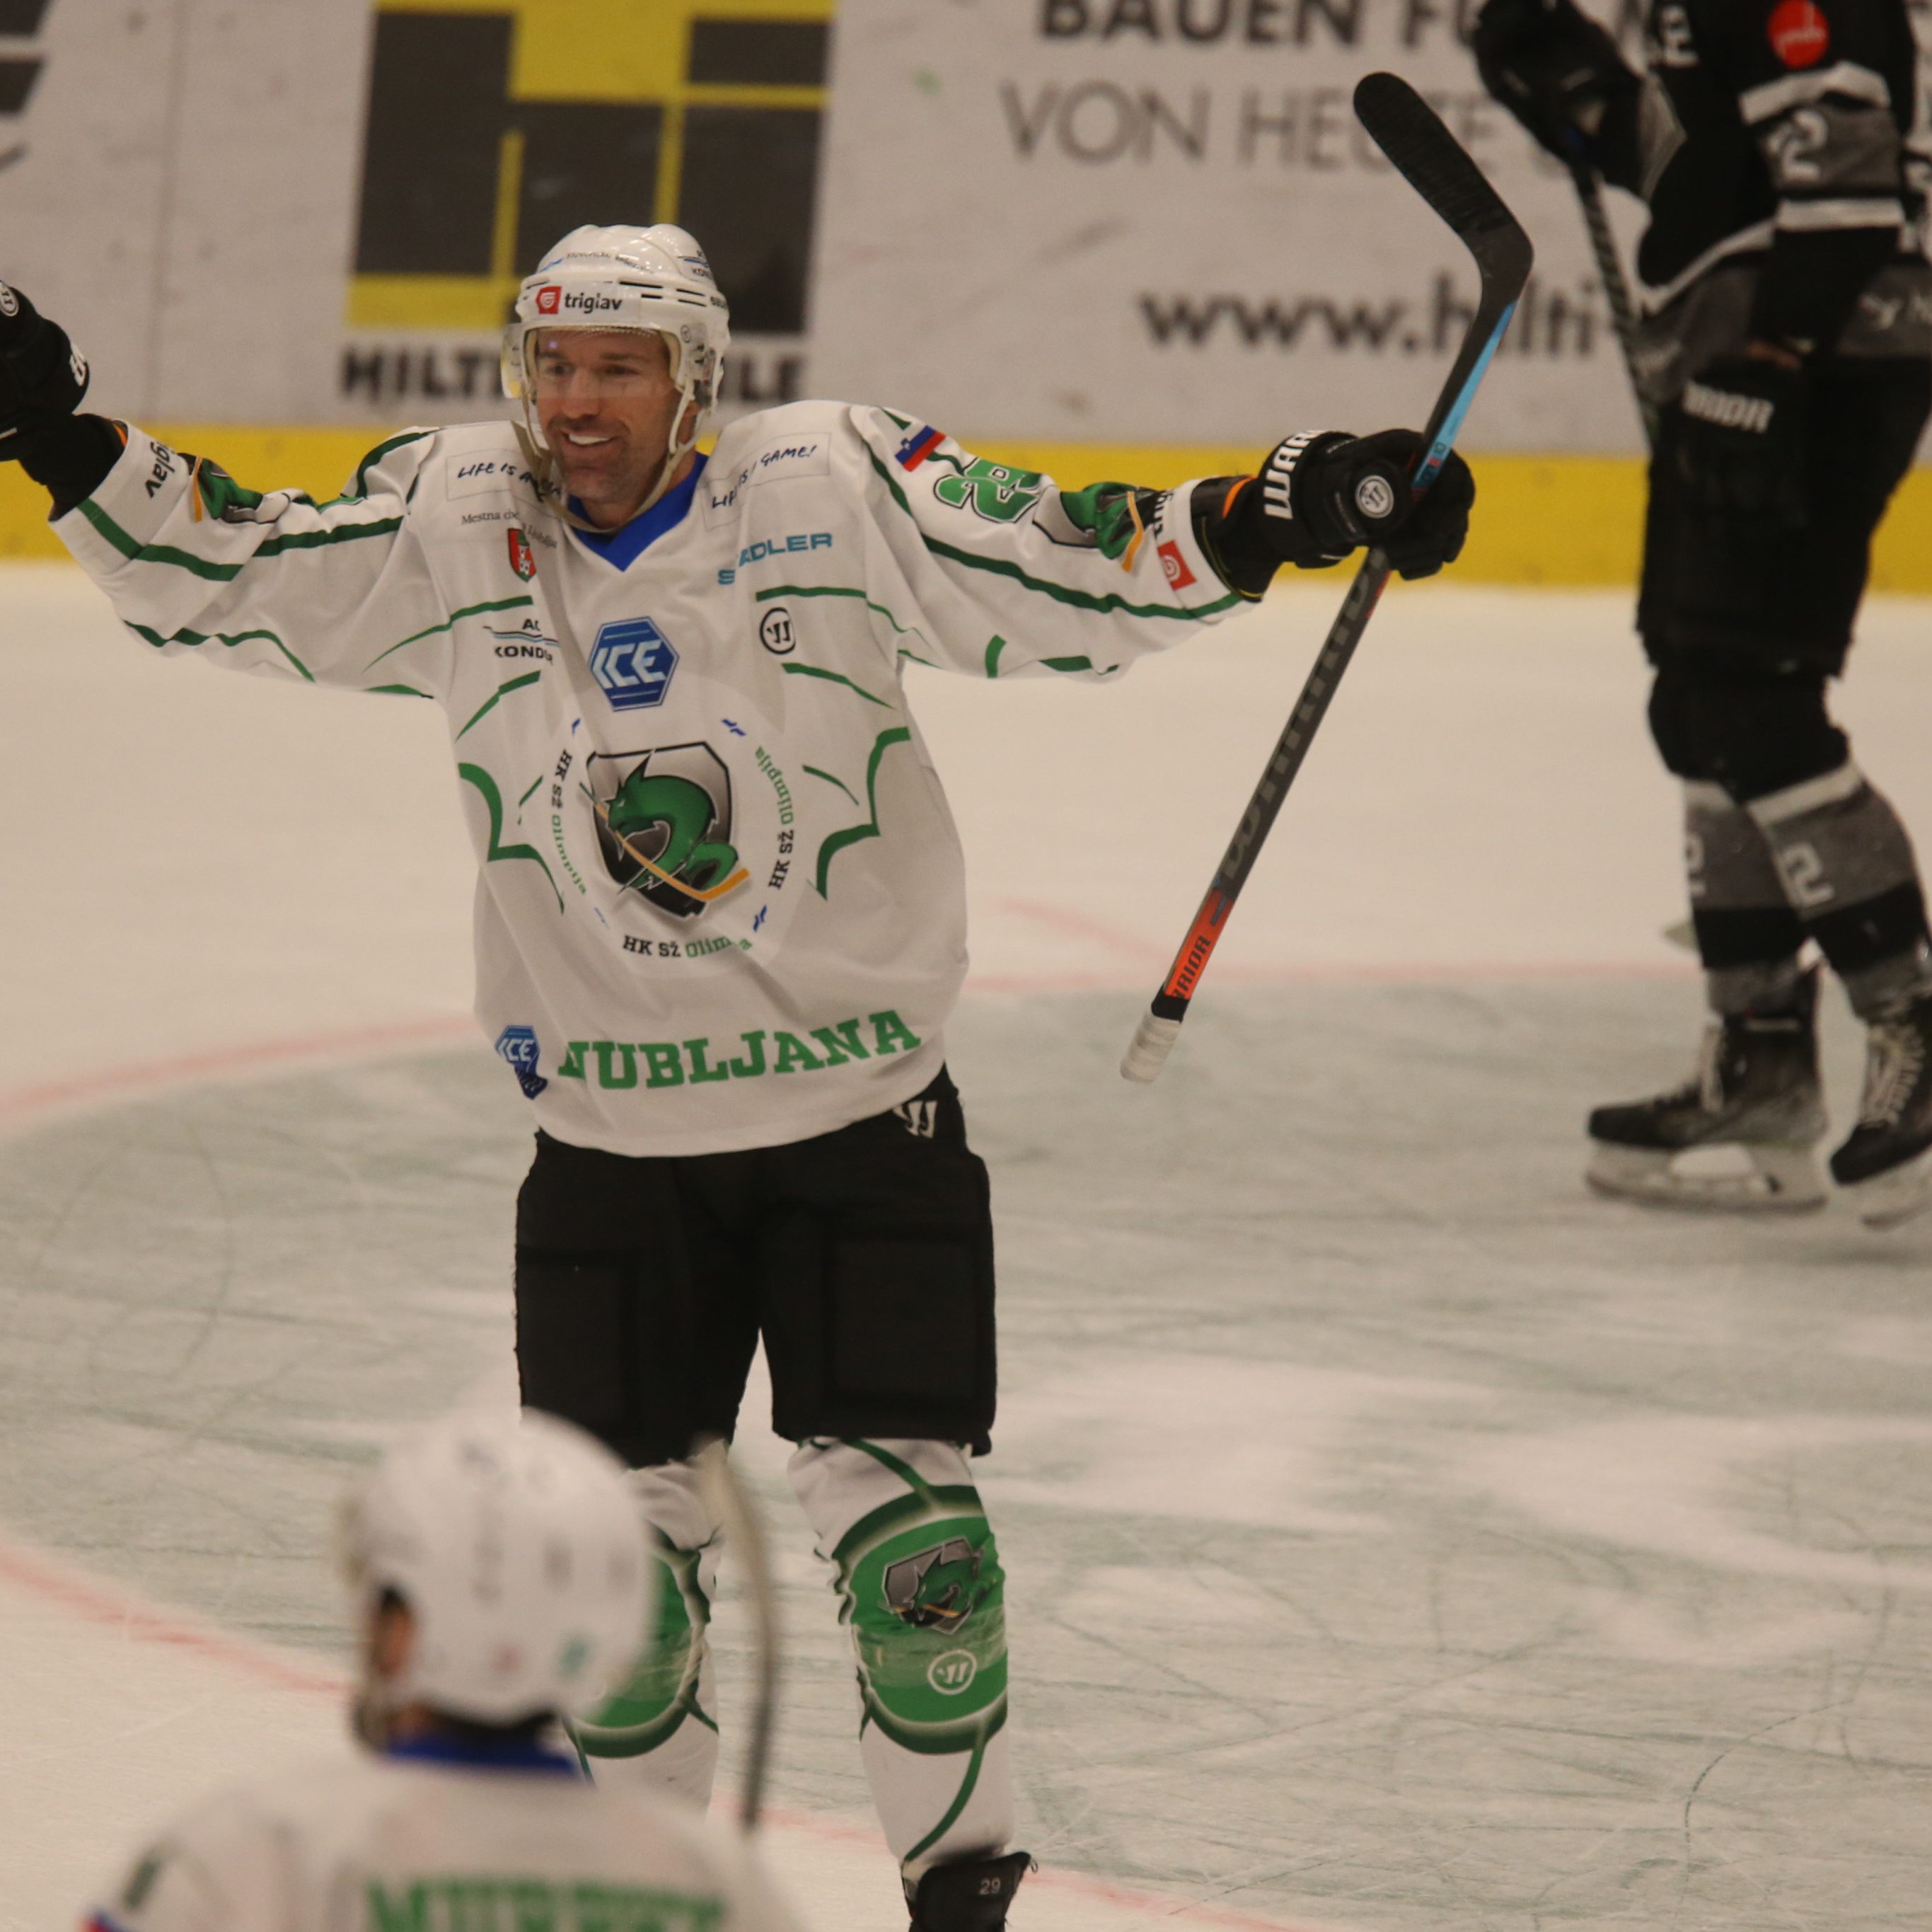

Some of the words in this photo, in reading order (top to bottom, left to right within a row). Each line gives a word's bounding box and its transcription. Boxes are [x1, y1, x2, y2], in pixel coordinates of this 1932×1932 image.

[999, 77, 1212, 164] VON
[565, 291, 623, 314] triglav
[760, 444, 818, 468] GAME!
[457, 462, 494, 479] LIFE
[593, 639, 664, 690] ICE
[754, 746, 794, 826] Olimpija
[768, 858, 792, 891] HK
[622, 934, 652, 957] HK
[979, 1876, 1002, 1897] 29
